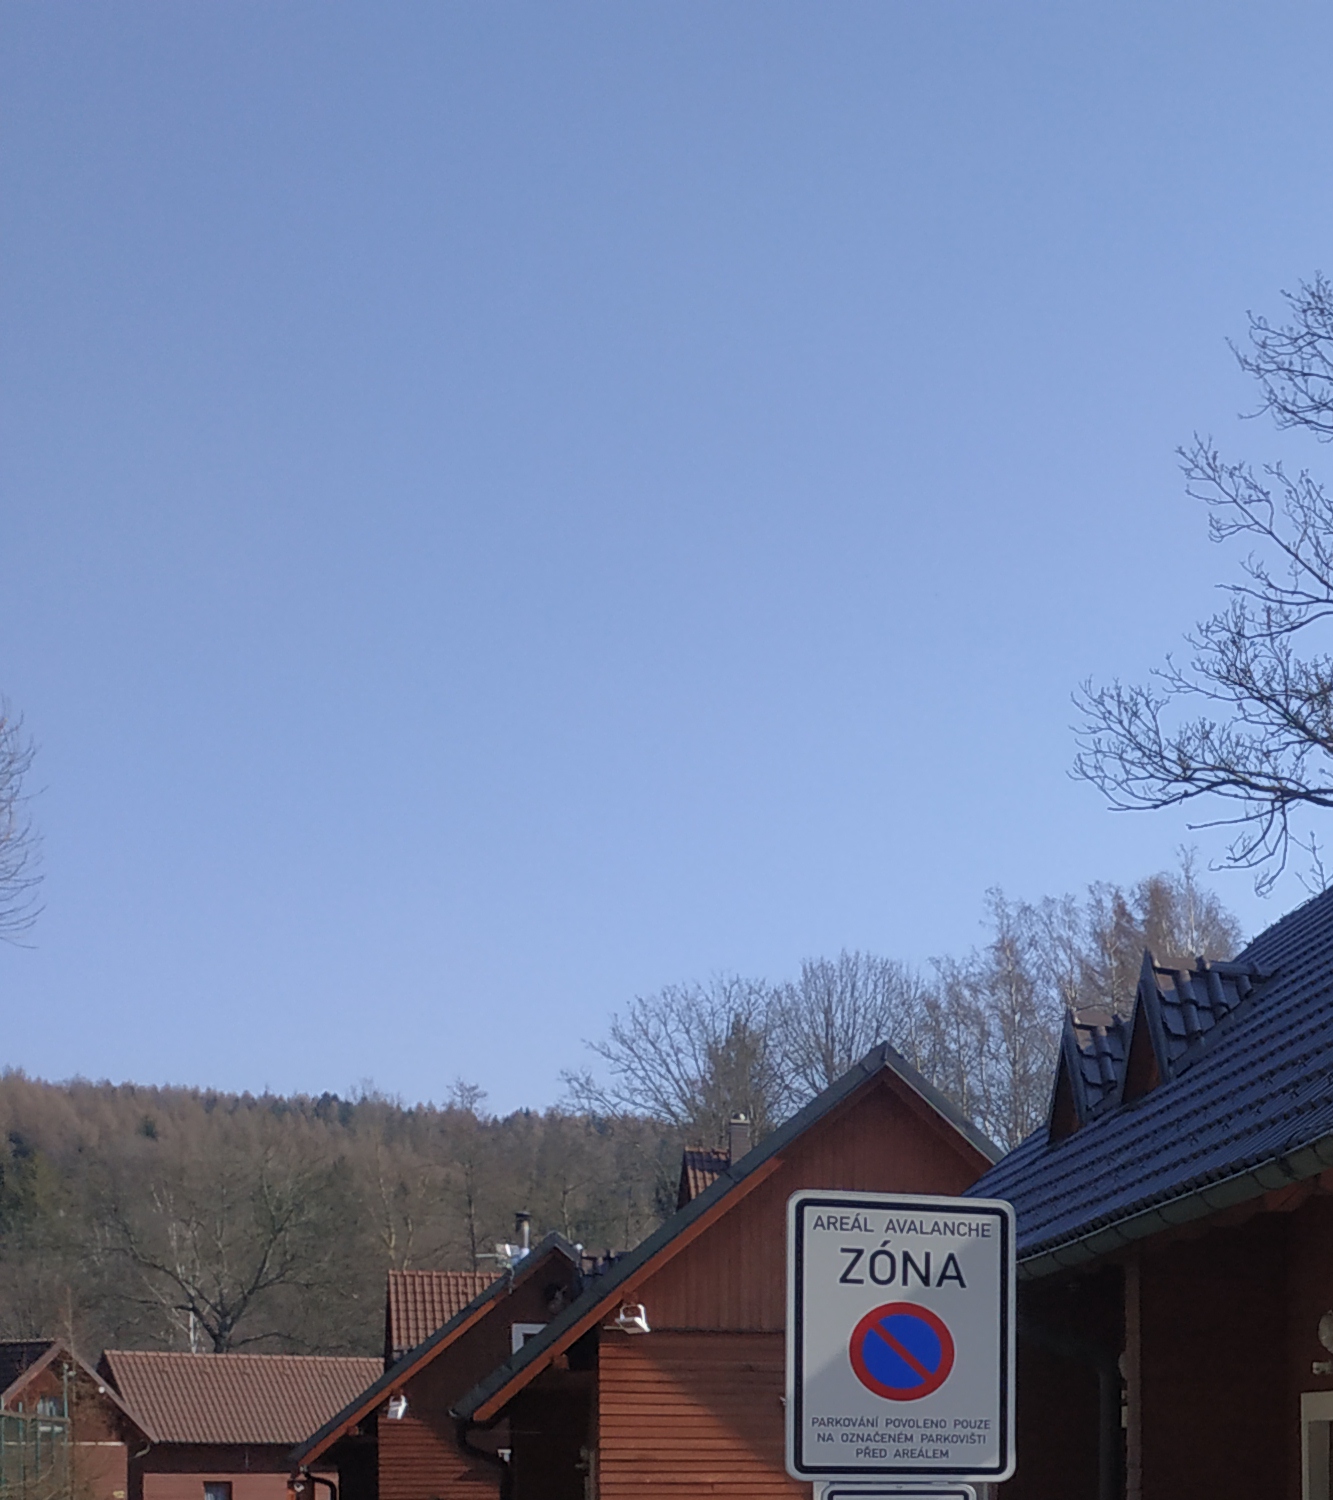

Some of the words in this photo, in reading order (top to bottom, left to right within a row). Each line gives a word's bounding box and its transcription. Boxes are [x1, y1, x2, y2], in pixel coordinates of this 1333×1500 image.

[813, 1213, 874, 1233] AREÁL
[884, 1218, 992, 1238] AVALANCHE
[839, 1240, 967, 1288] ZÓNA
[811, 1416, 879, 1428] PARKOVÁNÍ
[885, 1418, 947, 1430] POVOLENO
[954, 1419, 991, 1430] POUZE
[817, 1433, 834, 1443] NA
[841, 1430, 914, 1444] OZNAČENÉM
[920, 1432, 986, 1445] PARKOVIŠTI
[856, 1446, 887, 1459] PŘED
[894, 1446, 950, 1459] AREÁLEM
